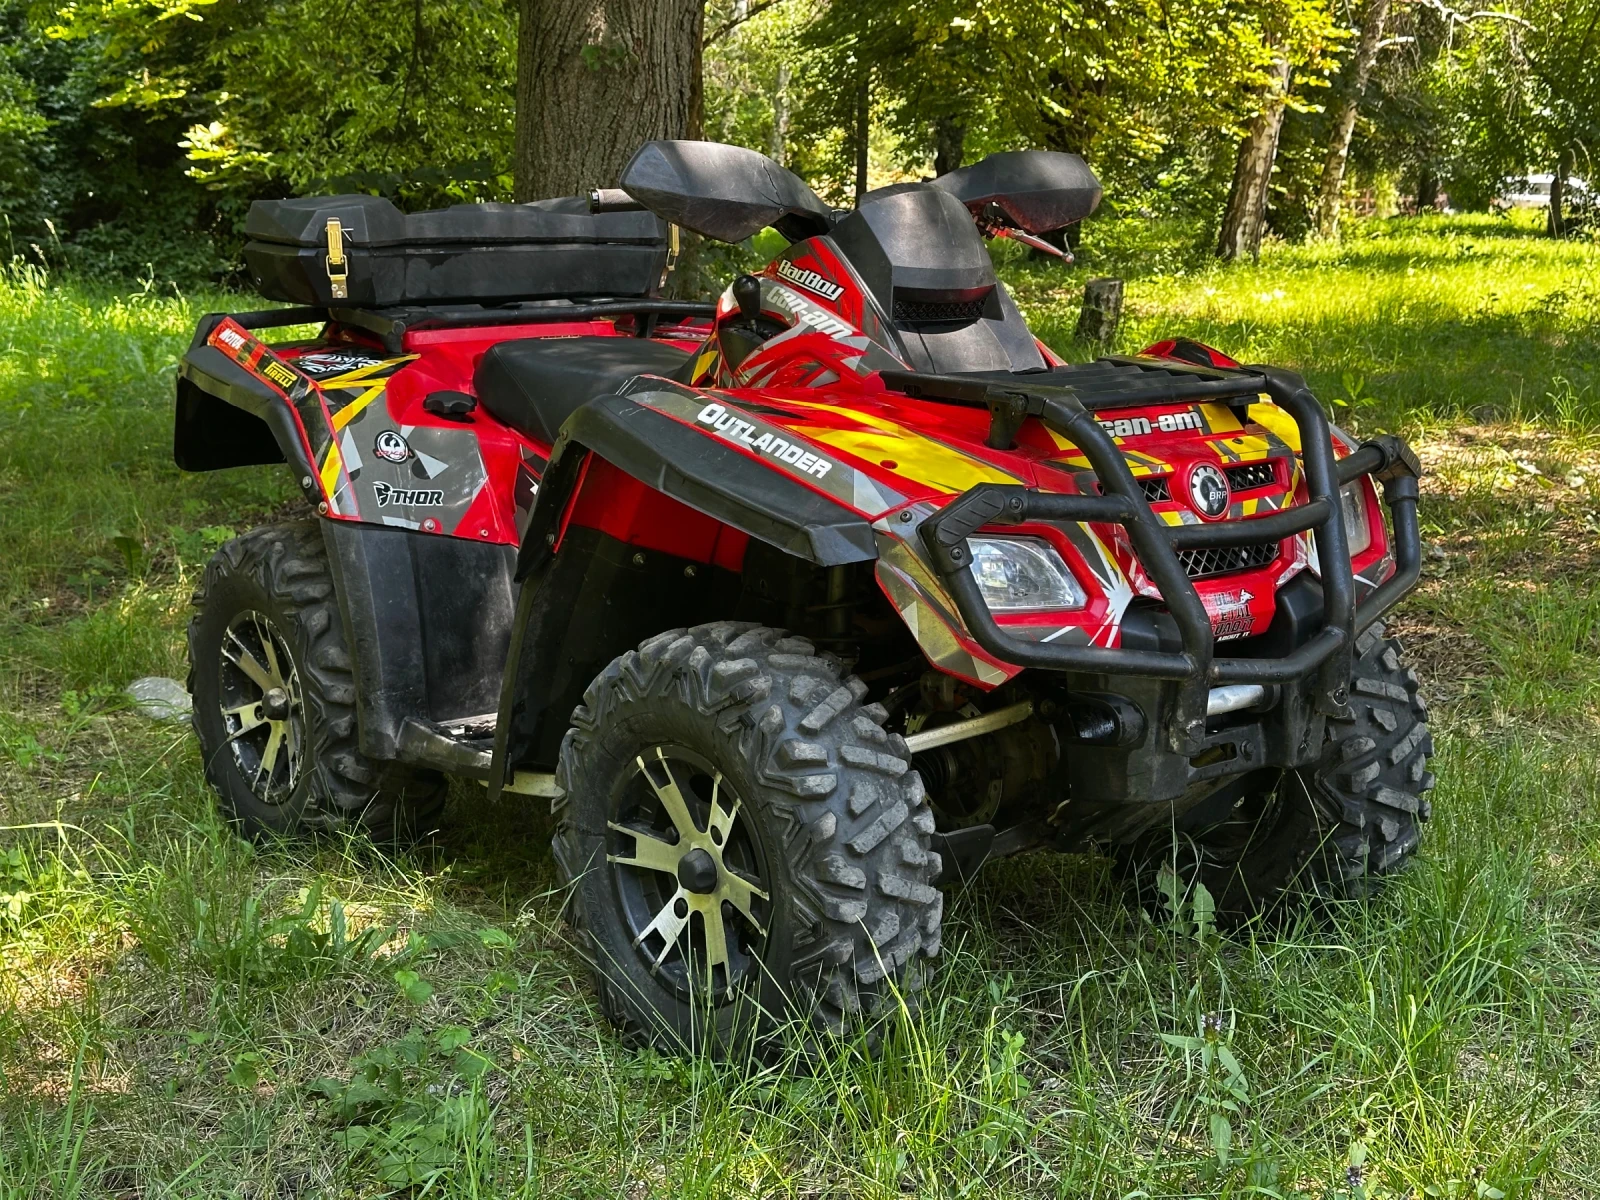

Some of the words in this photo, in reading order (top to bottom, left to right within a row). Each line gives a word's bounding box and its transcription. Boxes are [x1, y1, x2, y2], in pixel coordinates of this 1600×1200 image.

[778, 259, 845, 301] BadBoy
[263, 361, 299, 388] PIRELLI
[391, 488, 444, 506] THOR
[1209, 490, 1227, 501] BRP
